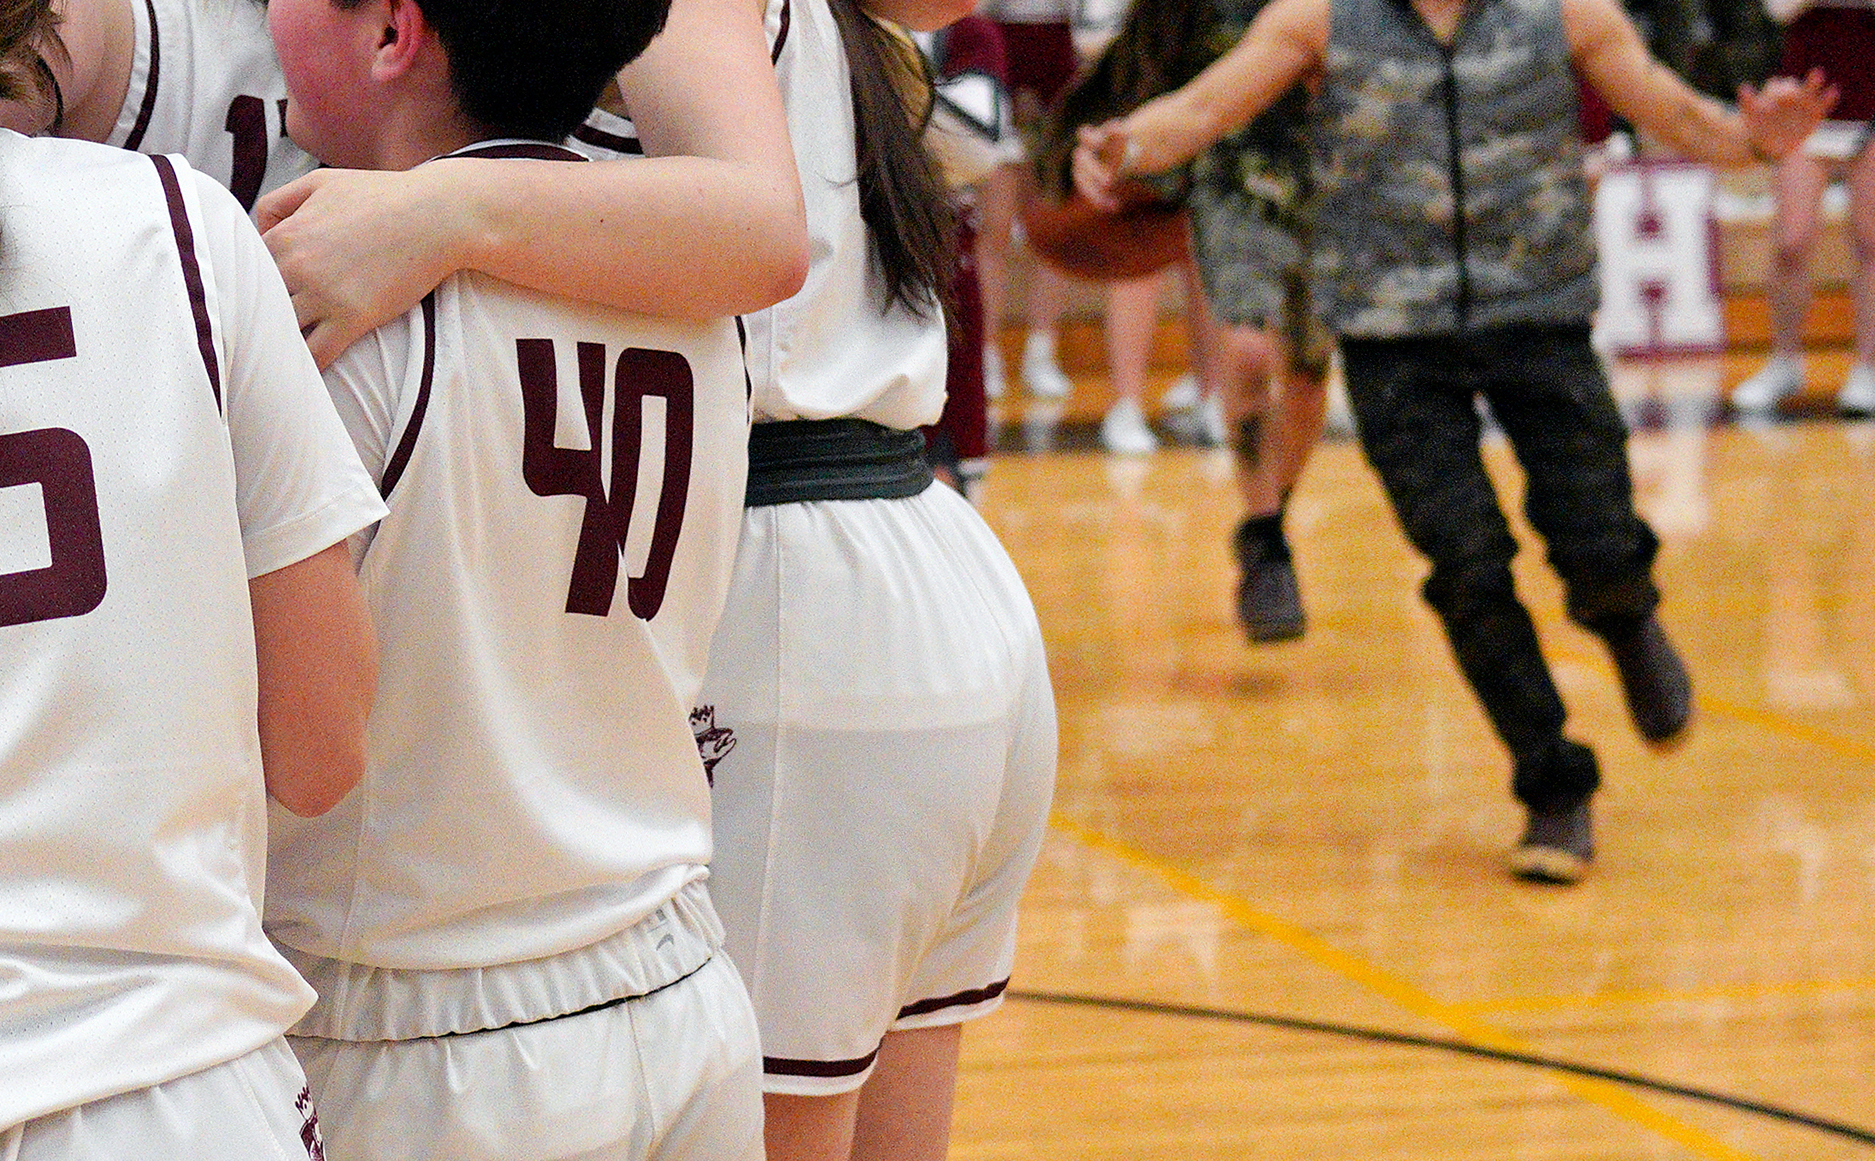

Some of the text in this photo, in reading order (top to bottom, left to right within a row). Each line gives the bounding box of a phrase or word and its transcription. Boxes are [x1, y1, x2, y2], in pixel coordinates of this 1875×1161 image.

[225, 94, 288, 214] 1
[1591, 168, 1725, 350] H
[516, 338, 694, 621] 40
